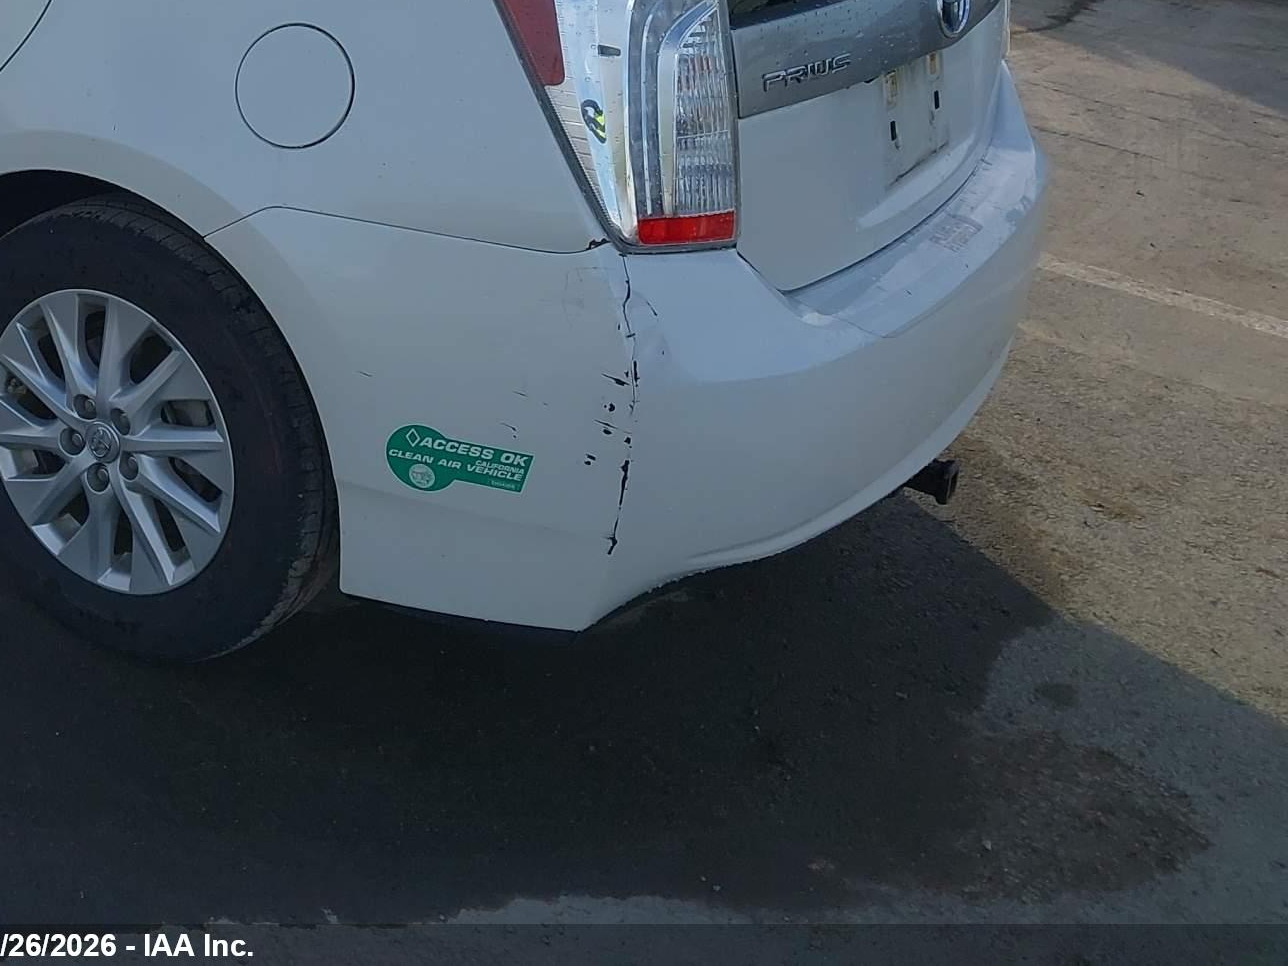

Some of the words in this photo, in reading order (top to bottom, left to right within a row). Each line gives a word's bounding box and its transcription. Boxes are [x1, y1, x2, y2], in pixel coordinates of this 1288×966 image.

[762, 52, 852, 93] PRIUS
[388, 449, 434, 464] CLEAN
[438, 458, 462, 470] AIR
[466, 464, 524, 482] VEHICLE
[419, 436, 494, 460] ACCESS
[500, 452, 529, 467] OK
[475, 459, 525, 475] CALIFORNIA
